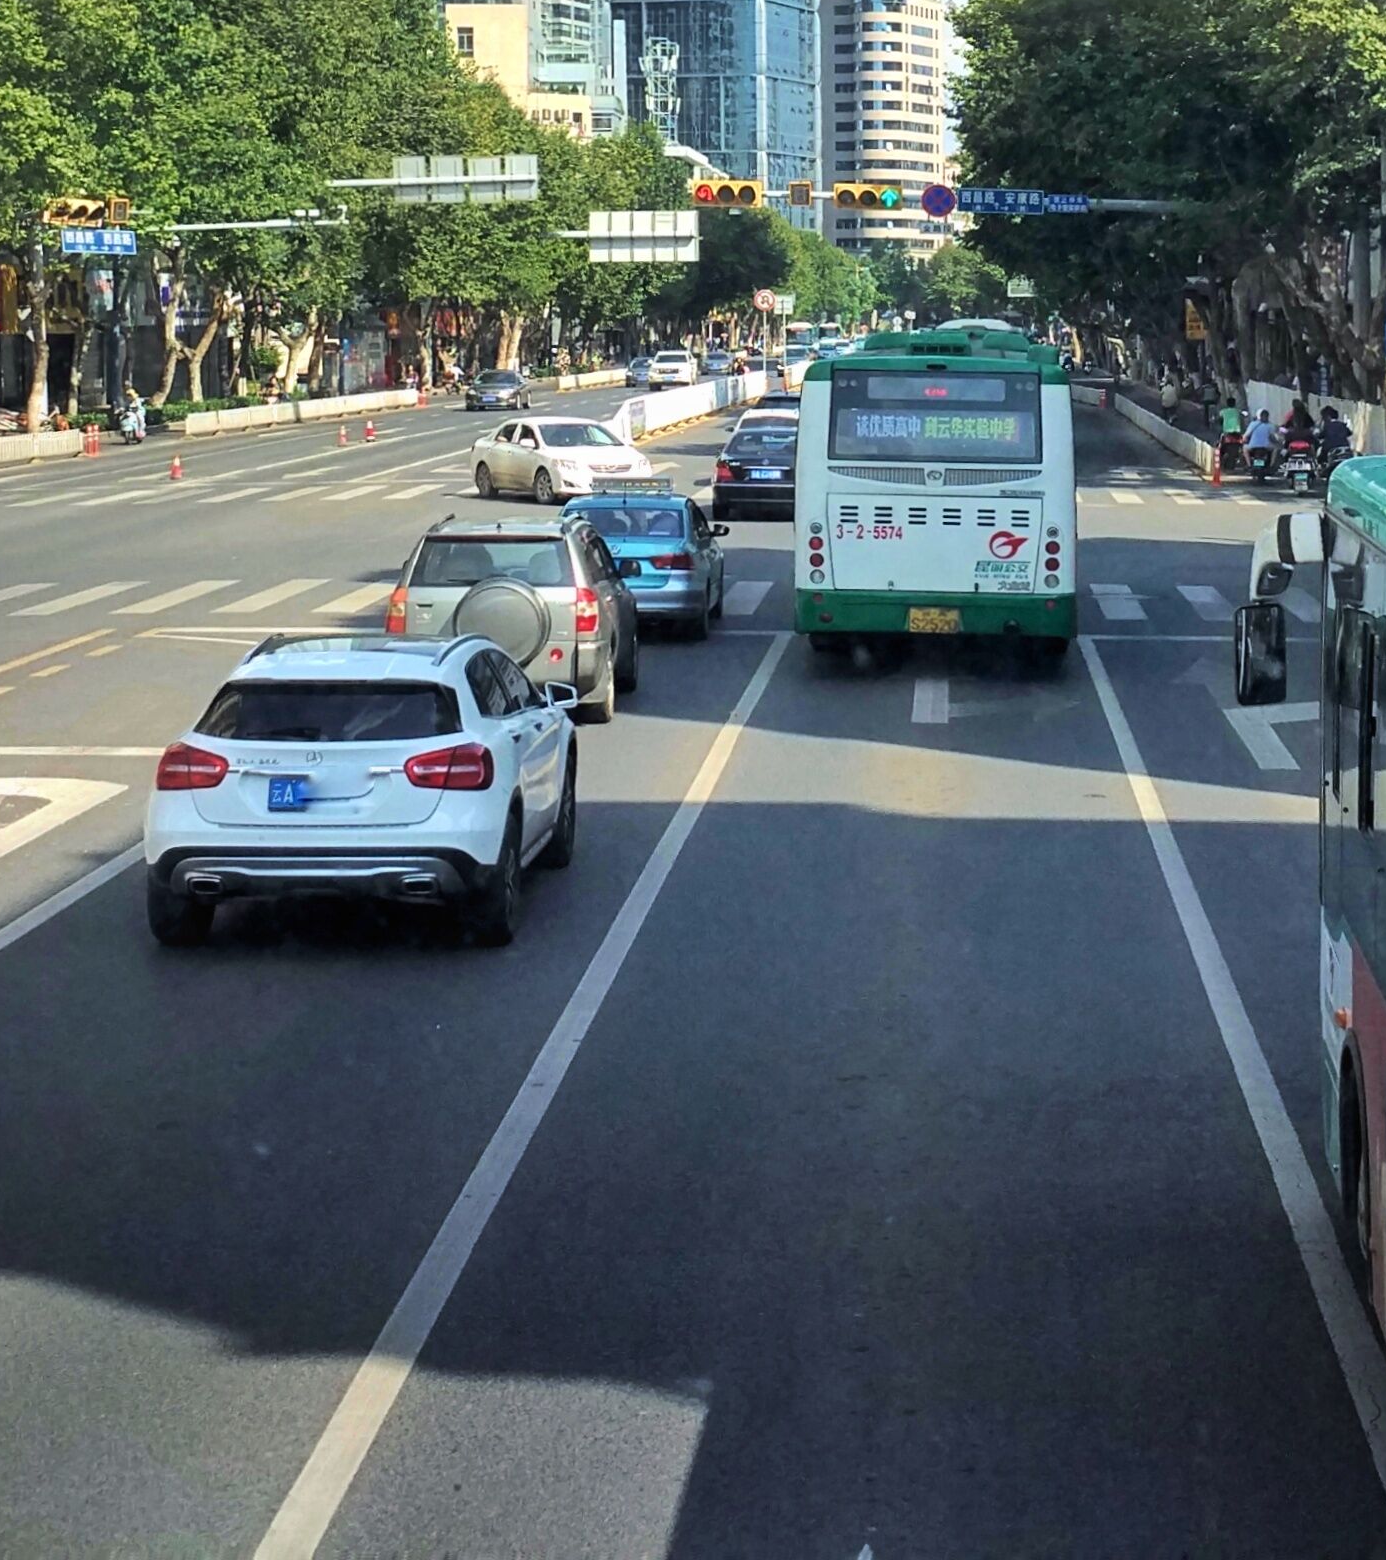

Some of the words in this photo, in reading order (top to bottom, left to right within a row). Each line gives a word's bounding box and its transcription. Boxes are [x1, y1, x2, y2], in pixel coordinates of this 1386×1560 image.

[1004, 192, 1041, 206] 安康路
[835, 523, 903, 541] 3-2-5574
